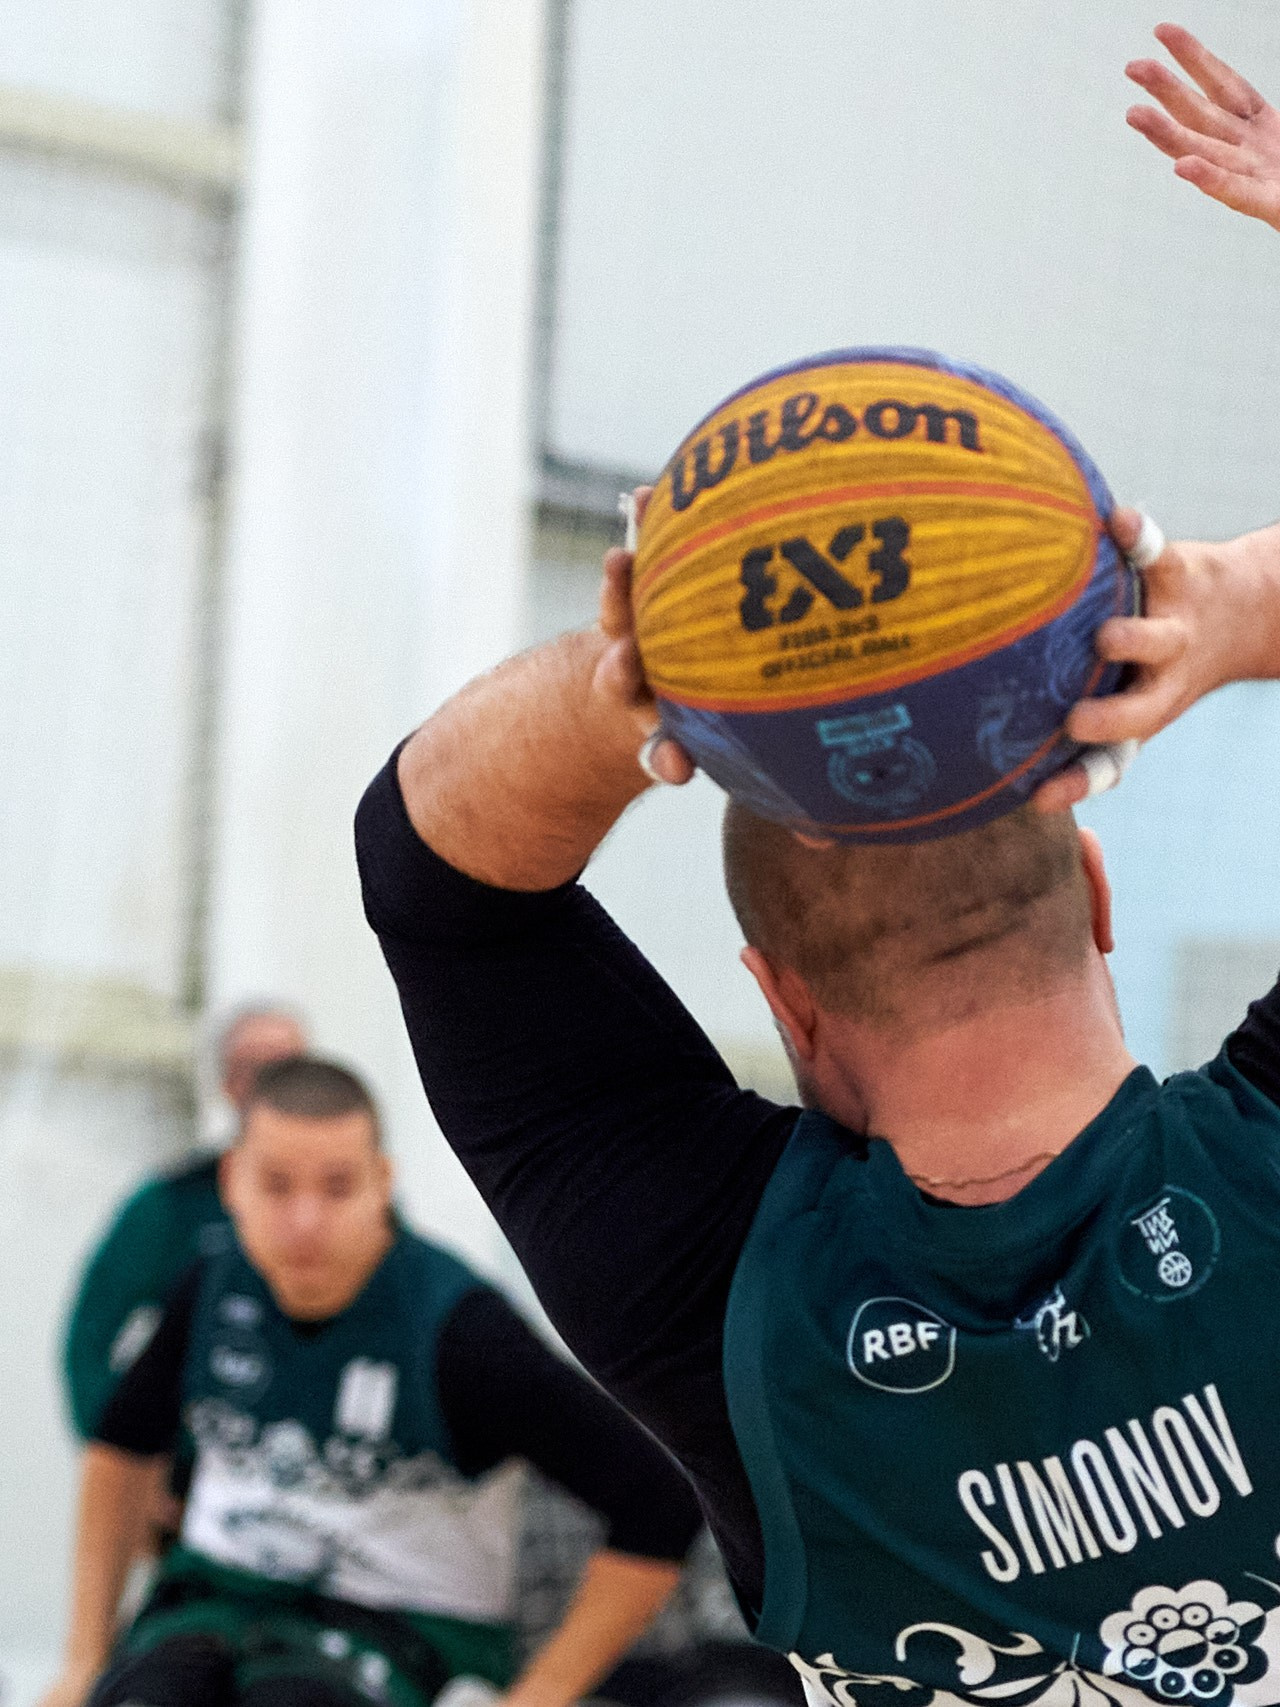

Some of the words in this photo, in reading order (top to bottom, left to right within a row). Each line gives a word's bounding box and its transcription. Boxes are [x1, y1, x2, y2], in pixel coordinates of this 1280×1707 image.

[669, 393, 984, 511] Wilson
[862, 1321, 943, 1364] RBF
[957, 1383, 1253, 1582] SIMONOV
